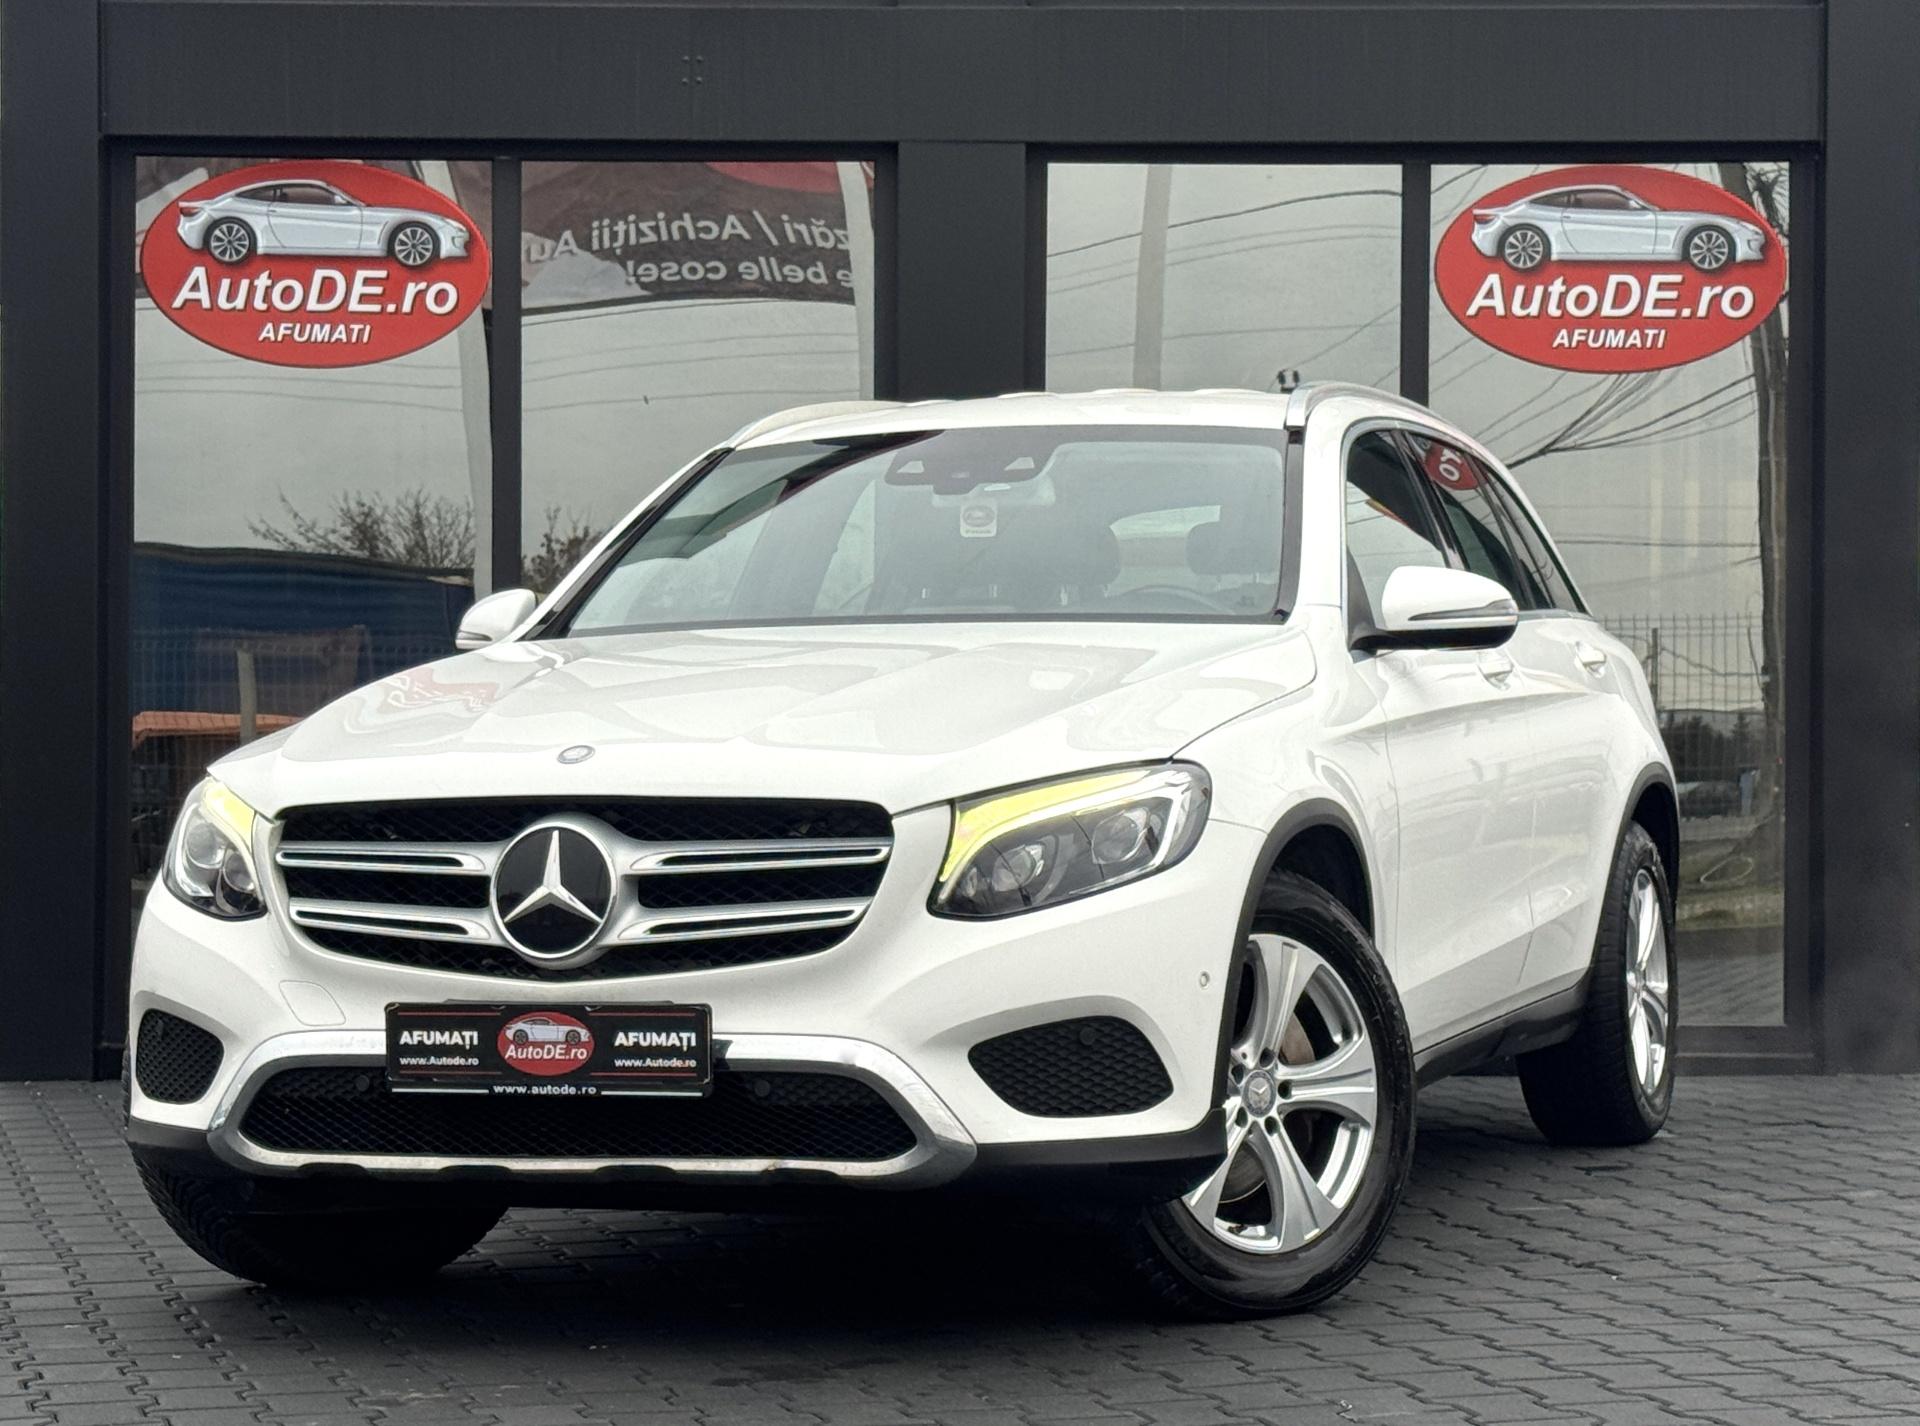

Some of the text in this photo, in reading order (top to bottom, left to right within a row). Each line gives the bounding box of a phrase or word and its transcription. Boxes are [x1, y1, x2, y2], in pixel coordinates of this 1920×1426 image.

[171, 266, 459, 315] AutoDE.ro
[1465, 273, 1755, 319] AutoDE.ro
[258, 323, 371, 344] AFUMATI
[1552, 328, 1667, 349] AFUMATI
[399, 1030, 479, 1049] AFUMAȚI
[614, 1031, 696, 1051] AFUMAȚI
[399, 1056, 479, 1067] www.Autode.ro
[505, 1043, 588, 1062] AutoDE.ro
[614, 1057, 697, 1068] www.Autode.ro
[493, 1082, 597, 1096] www.autode.ro
